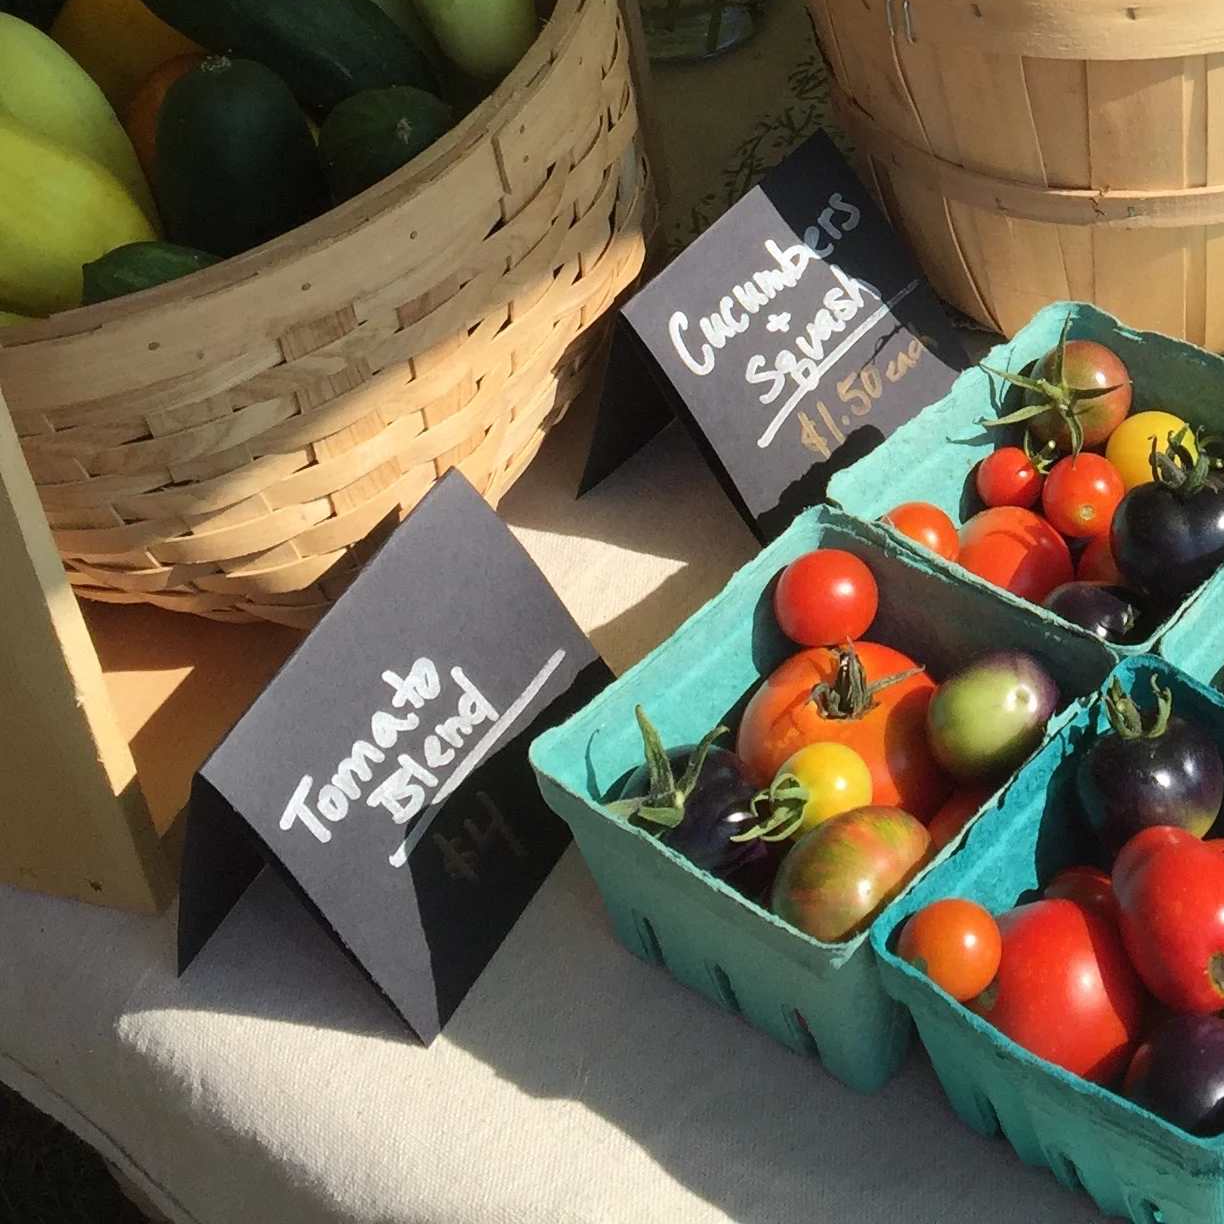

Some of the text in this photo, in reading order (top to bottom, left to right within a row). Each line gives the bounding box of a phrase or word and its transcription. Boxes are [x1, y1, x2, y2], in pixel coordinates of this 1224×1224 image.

[669, 192, 861, 375] Cucumbers
[746, 264, 883, 404] Squash
[797, 364, 883, 459] $1.50
[279, 657, 441, 843] Tomato
[366, 666, 499, 825] Blend
